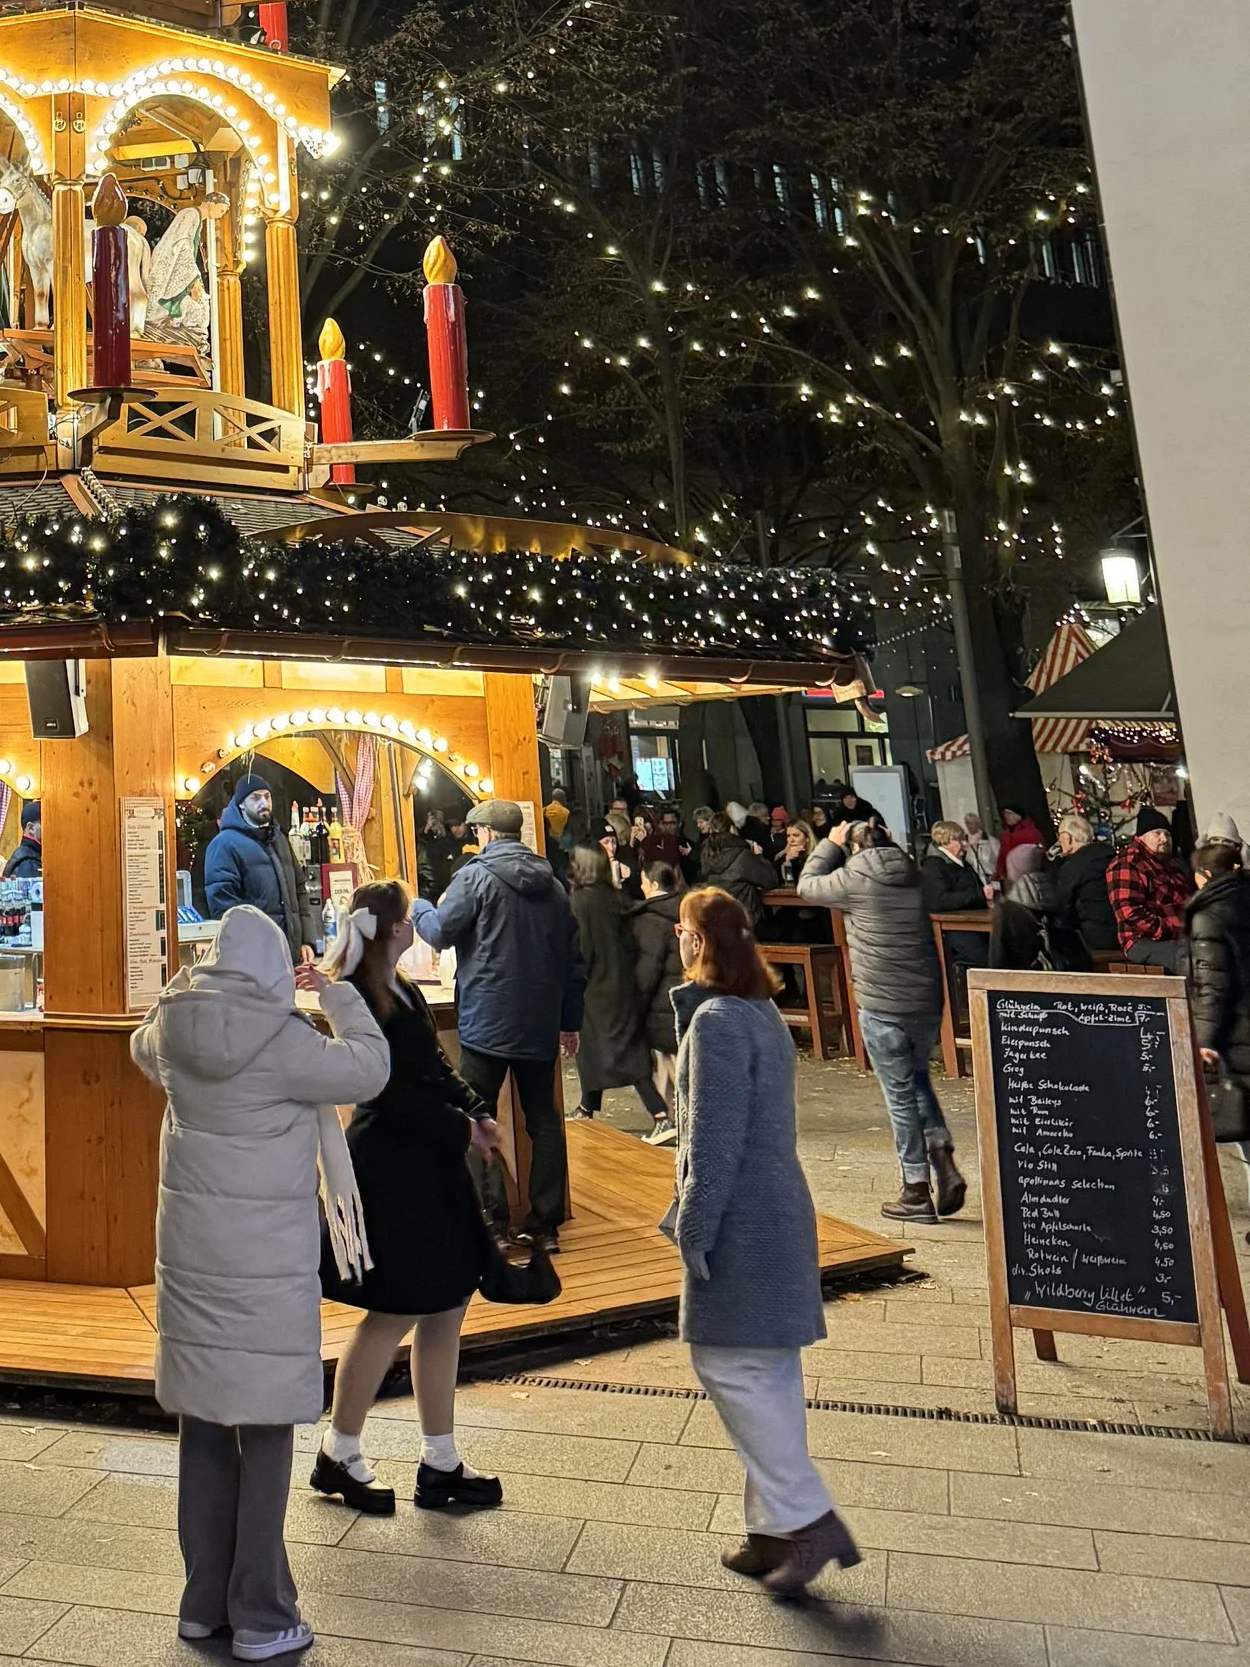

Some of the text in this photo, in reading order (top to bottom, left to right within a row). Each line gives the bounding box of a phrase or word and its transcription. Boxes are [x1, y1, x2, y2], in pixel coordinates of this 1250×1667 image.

[1001, 1035, 1051, 1050] Eierpunsch
[1003, 1063, 1024, 1076] Grog
[1020, 1191, 1071, 1204] Almdudler
[1020, 1206, 1039, 1218] Red
[1042, 1206, 1060, 1218] Bull
[1024, 1232, 1071, 1248] Heineken
